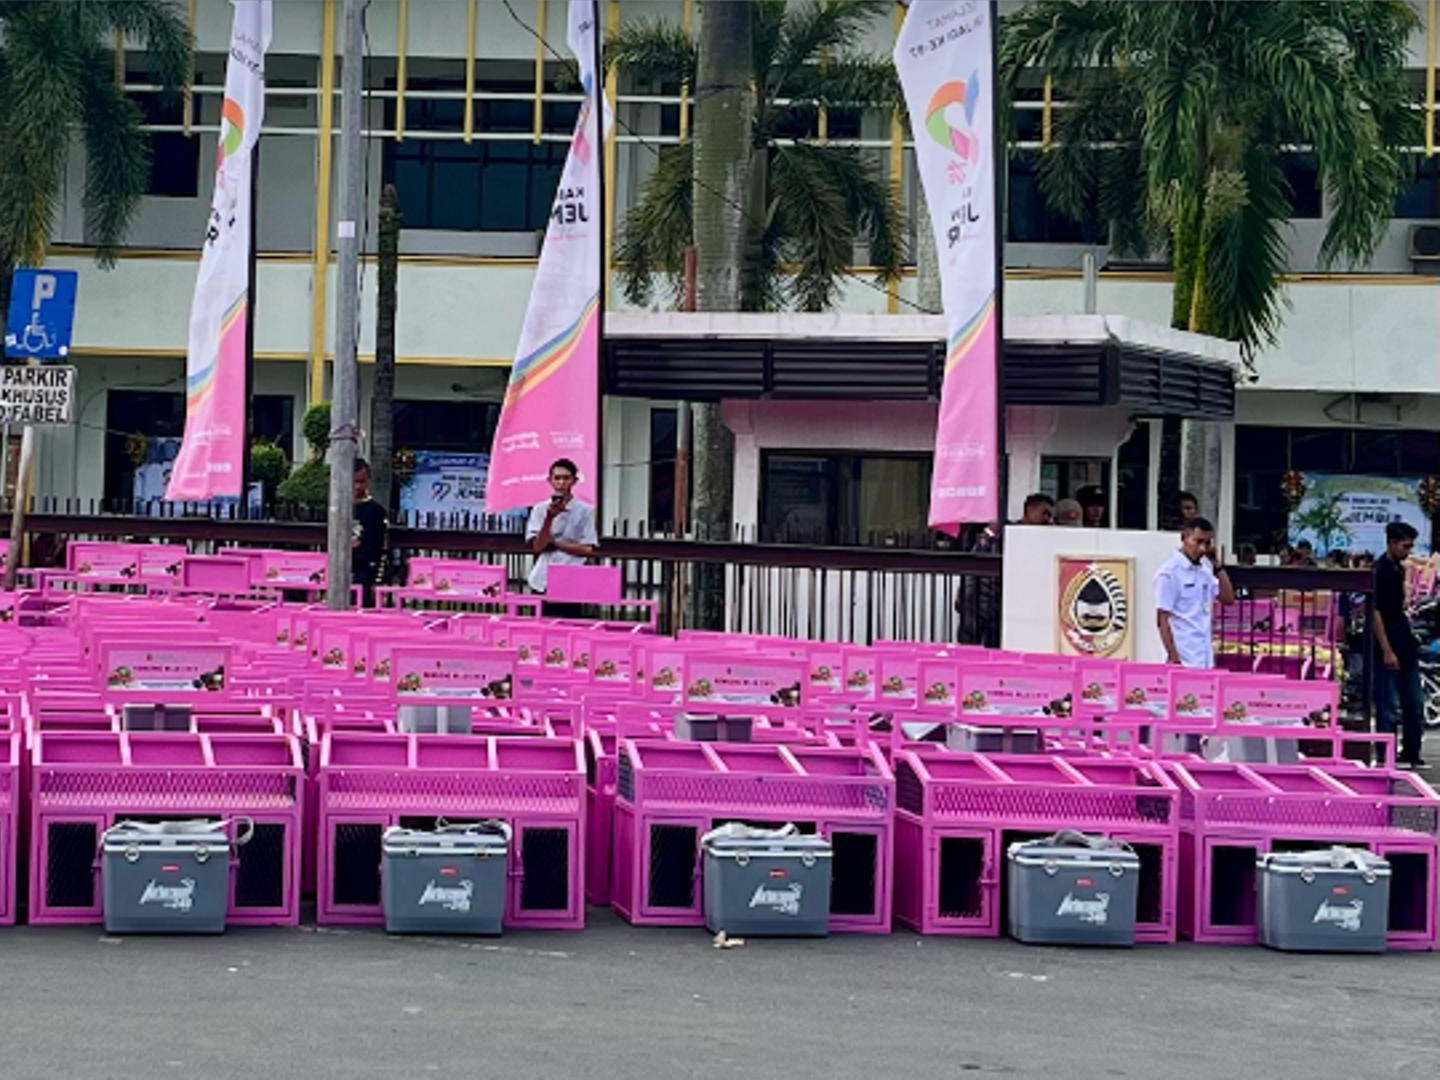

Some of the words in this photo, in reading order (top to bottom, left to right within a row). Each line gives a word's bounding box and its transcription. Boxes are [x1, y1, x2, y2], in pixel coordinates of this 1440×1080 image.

[32, 274, 56, 309] P
[3, 368, 68, 388] PARKIR
[0, 388, 68, 407] KHUSUS
